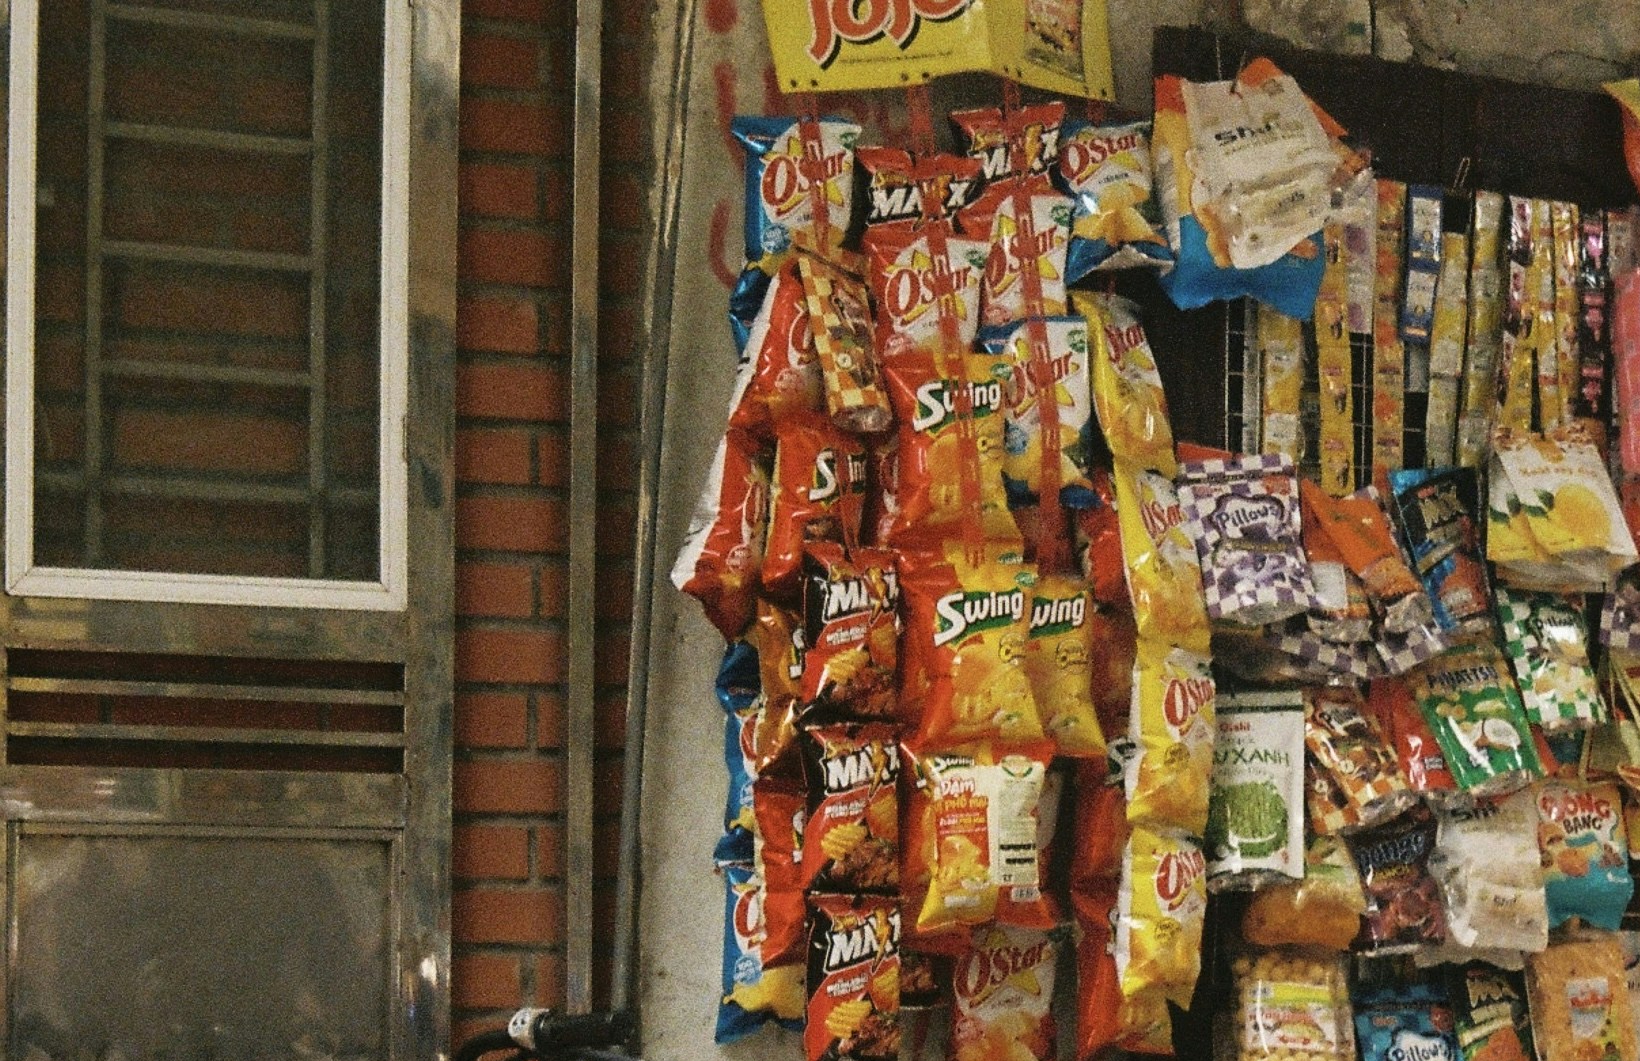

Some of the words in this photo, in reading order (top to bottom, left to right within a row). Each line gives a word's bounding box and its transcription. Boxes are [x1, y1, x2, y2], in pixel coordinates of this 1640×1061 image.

[761, 153, 846, 206] O'Sar
[1060, 134, 1138, 181] O'Star
[984, 226, 1057, 287] O'Sar
[886, 266, 971, 319] O'Sar
[1216, 503, 1278, 530] Pillows
[934, 591, 1024, 647] Swing
[1562, 814, 1602, 834] BANG
[954, 941, 1048, 999] O'Star
